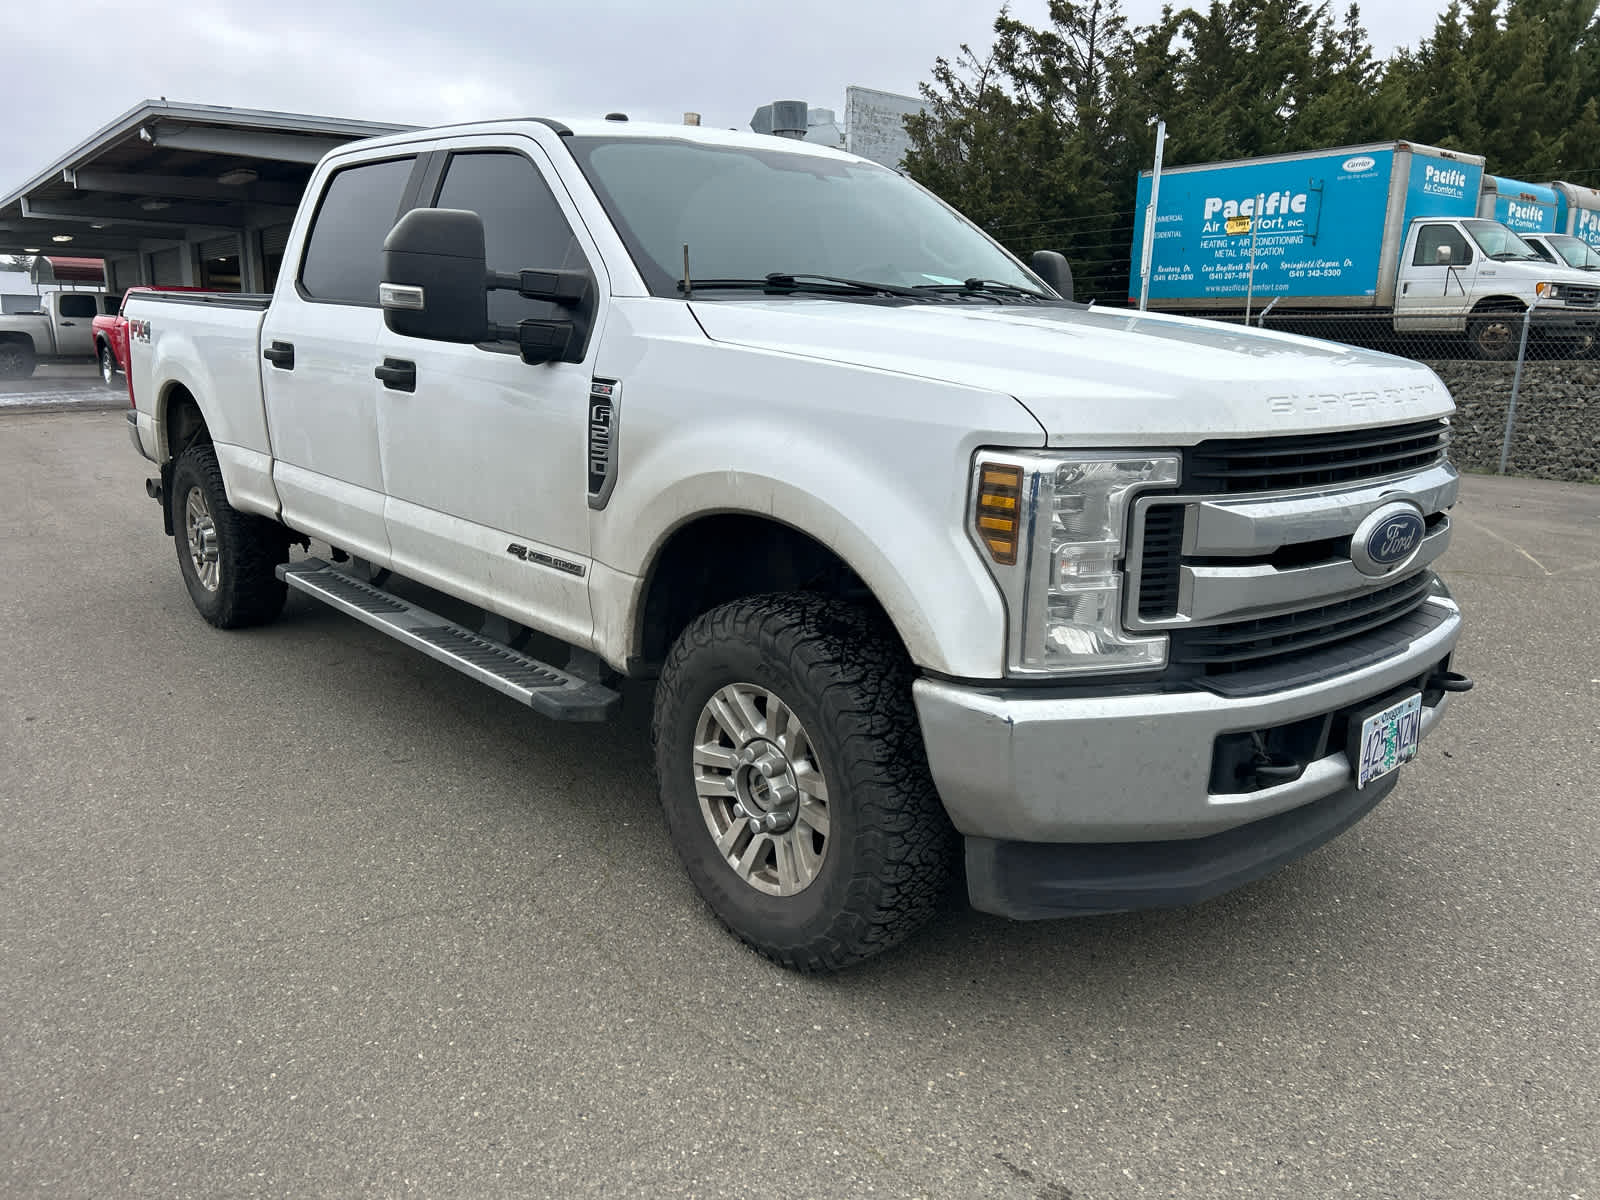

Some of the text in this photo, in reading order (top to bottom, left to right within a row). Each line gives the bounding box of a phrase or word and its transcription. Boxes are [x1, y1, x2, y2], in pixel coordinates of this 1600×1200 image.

[1347, 160, 1371, 168] Carrier
[1425, 165, 1466, 188] Pacific
[1424, 183, 1432, 192] Air
[1203, 191, 1307, 220] Pacific
[1508, 202, 1544, 222] Pacific
[1203, 221, 1220, 233] Air
[1579, 209, 1600, 232] Pa
[1200, 235, 1304, 249] HEATING AIR CONDITIONING
[1214, 249, 1237, 258] METAL
[1288, 270, 1305, 278] (541)
[1267, 391, 1378, 415] SUPER
[1380, 522, 1416, 557] Ford
[1364, 725, 1389, 768] 425
